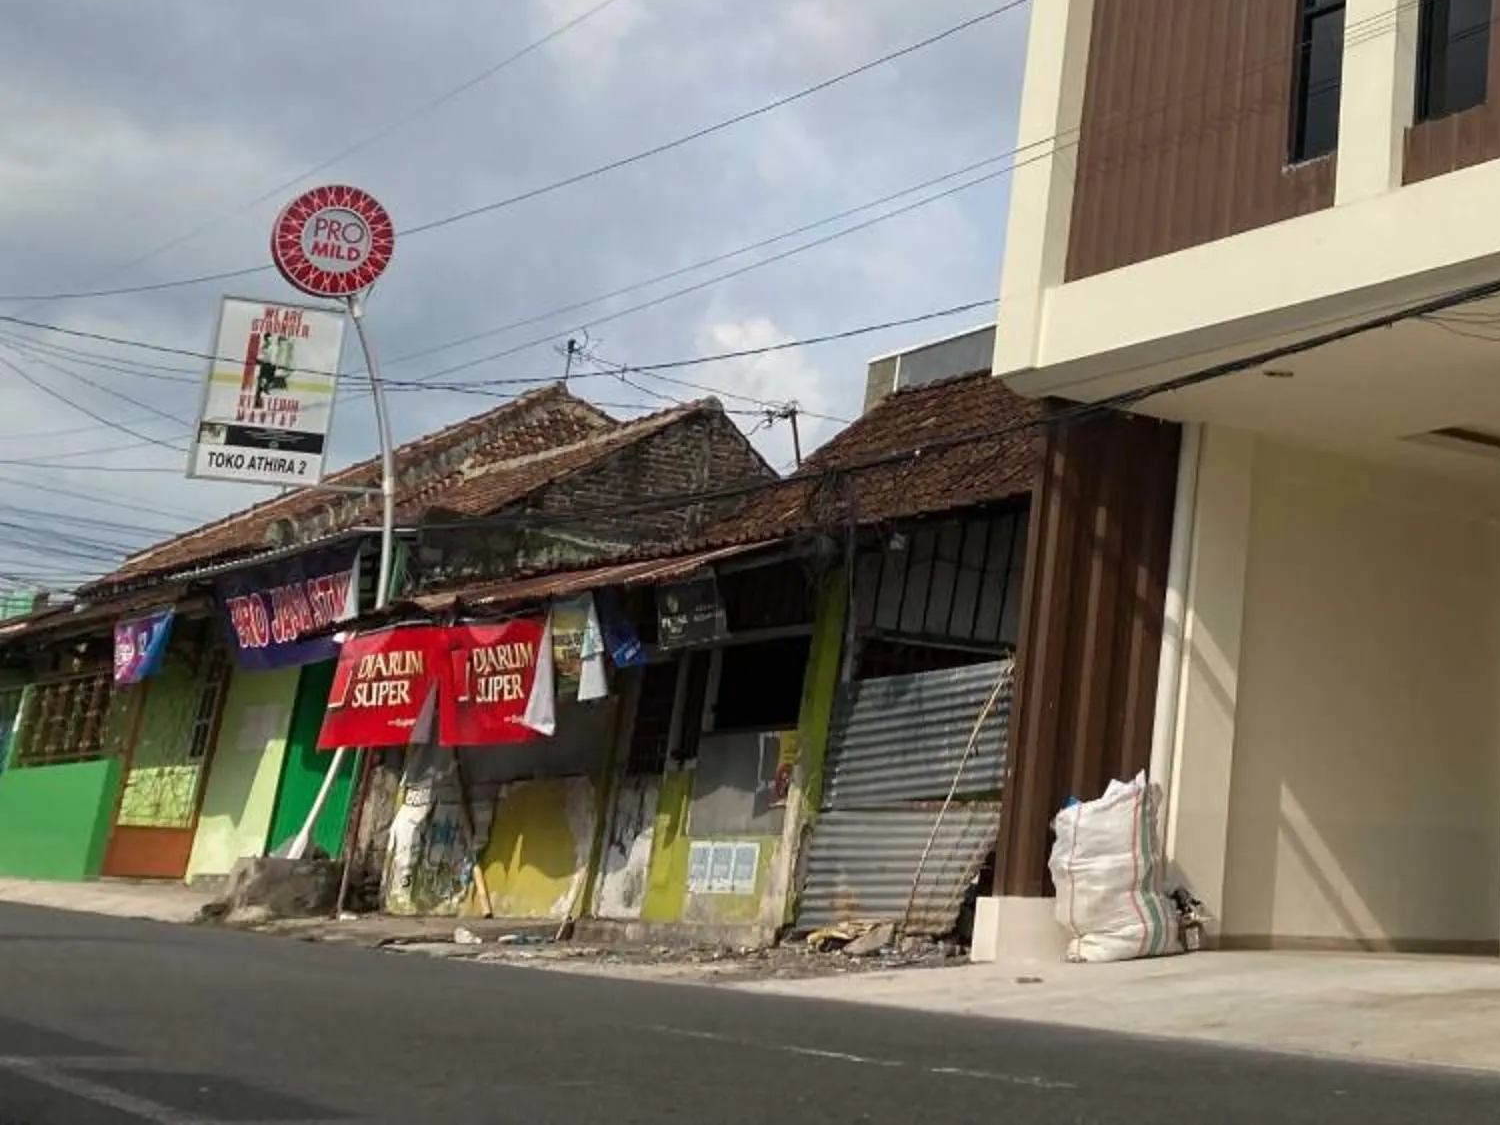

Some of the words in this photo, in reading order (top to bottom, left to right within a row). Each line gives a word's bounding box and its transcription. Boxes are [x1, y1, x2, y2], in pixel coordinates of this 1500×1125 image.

[314, 217, 365, 244] PRO
[311, 241, 361, 262] MILD
[208, 452, 245, 470] TOKO
[248, 455, 295, 474] ATHIRA
[298, 460, 308, 476] 2
[357, 650, 424, 681] DJARUM
[472, 641, 533, 676] DJARUM
[351, 680, 411, 709] SUPER
